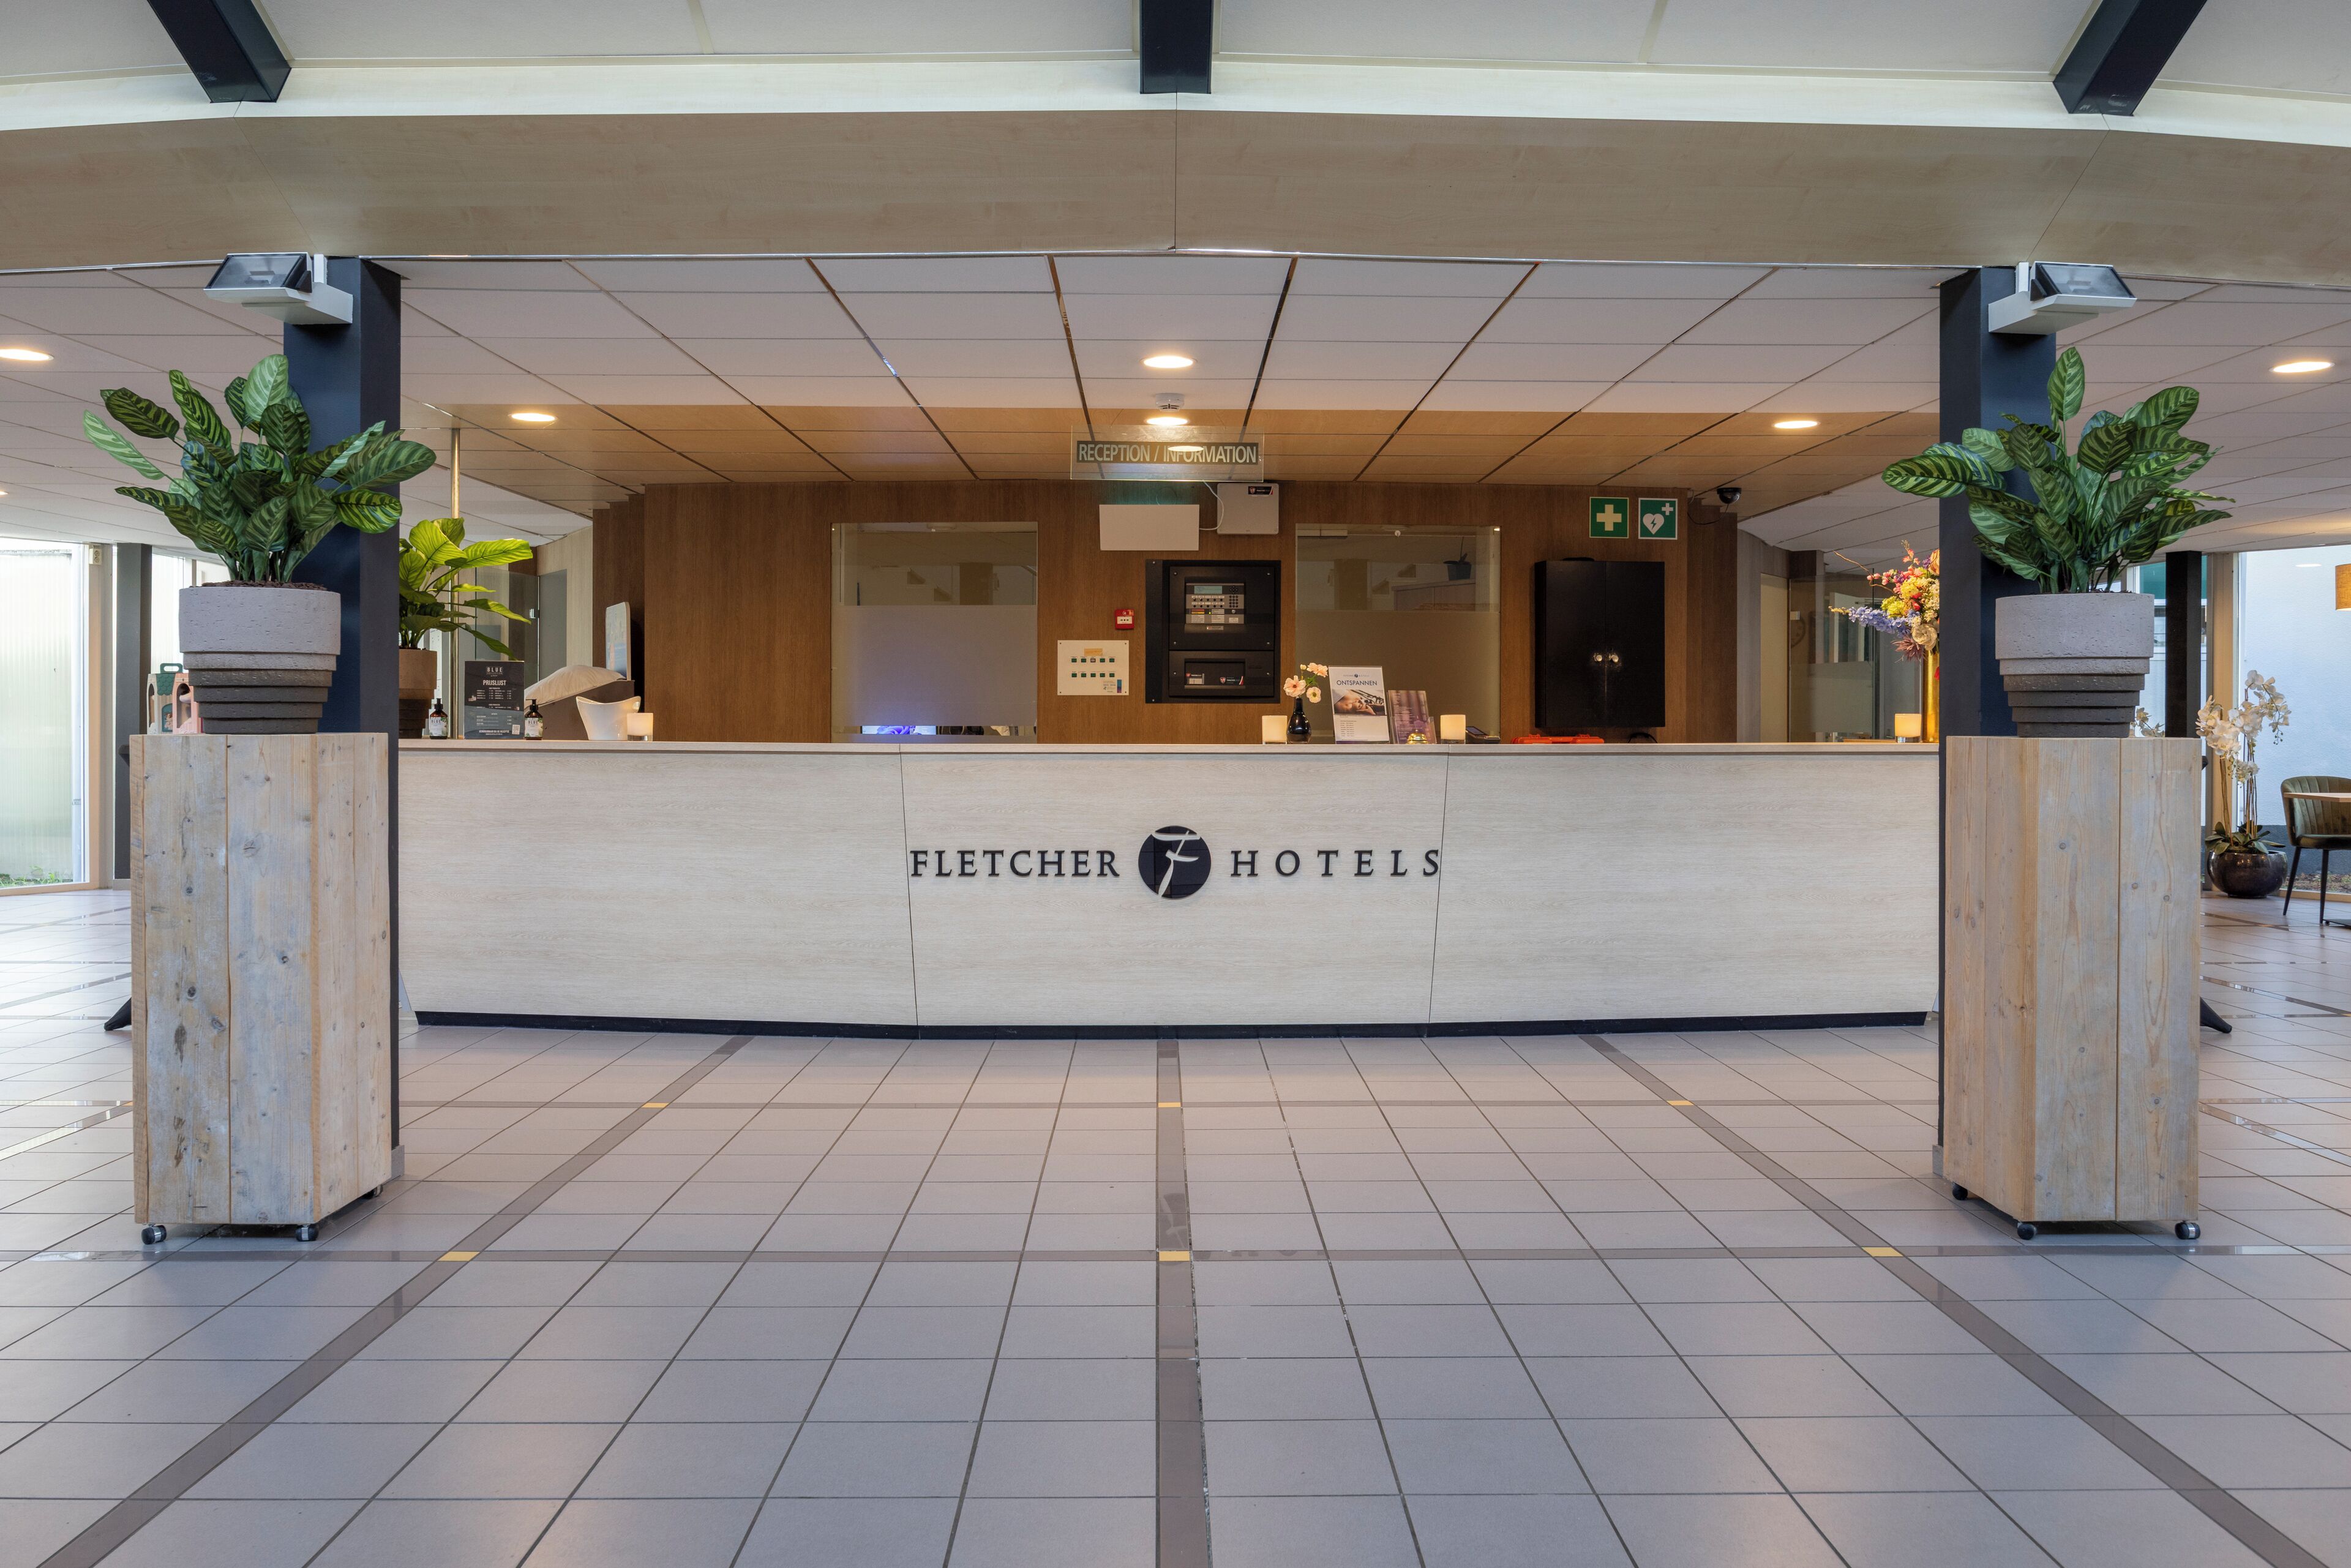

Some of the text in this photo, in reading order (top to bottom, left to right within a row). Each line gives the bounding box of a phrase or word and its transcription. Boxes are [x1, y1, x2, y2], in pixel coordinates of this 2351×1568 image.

[1079, 444, 1150, 462] RECEPTION
[1163, 446, 1256, 463] INFORMATION
[910, 850, 1120, 876] FLETCHER
[1230, 849, 1439, 877] HOTELS
